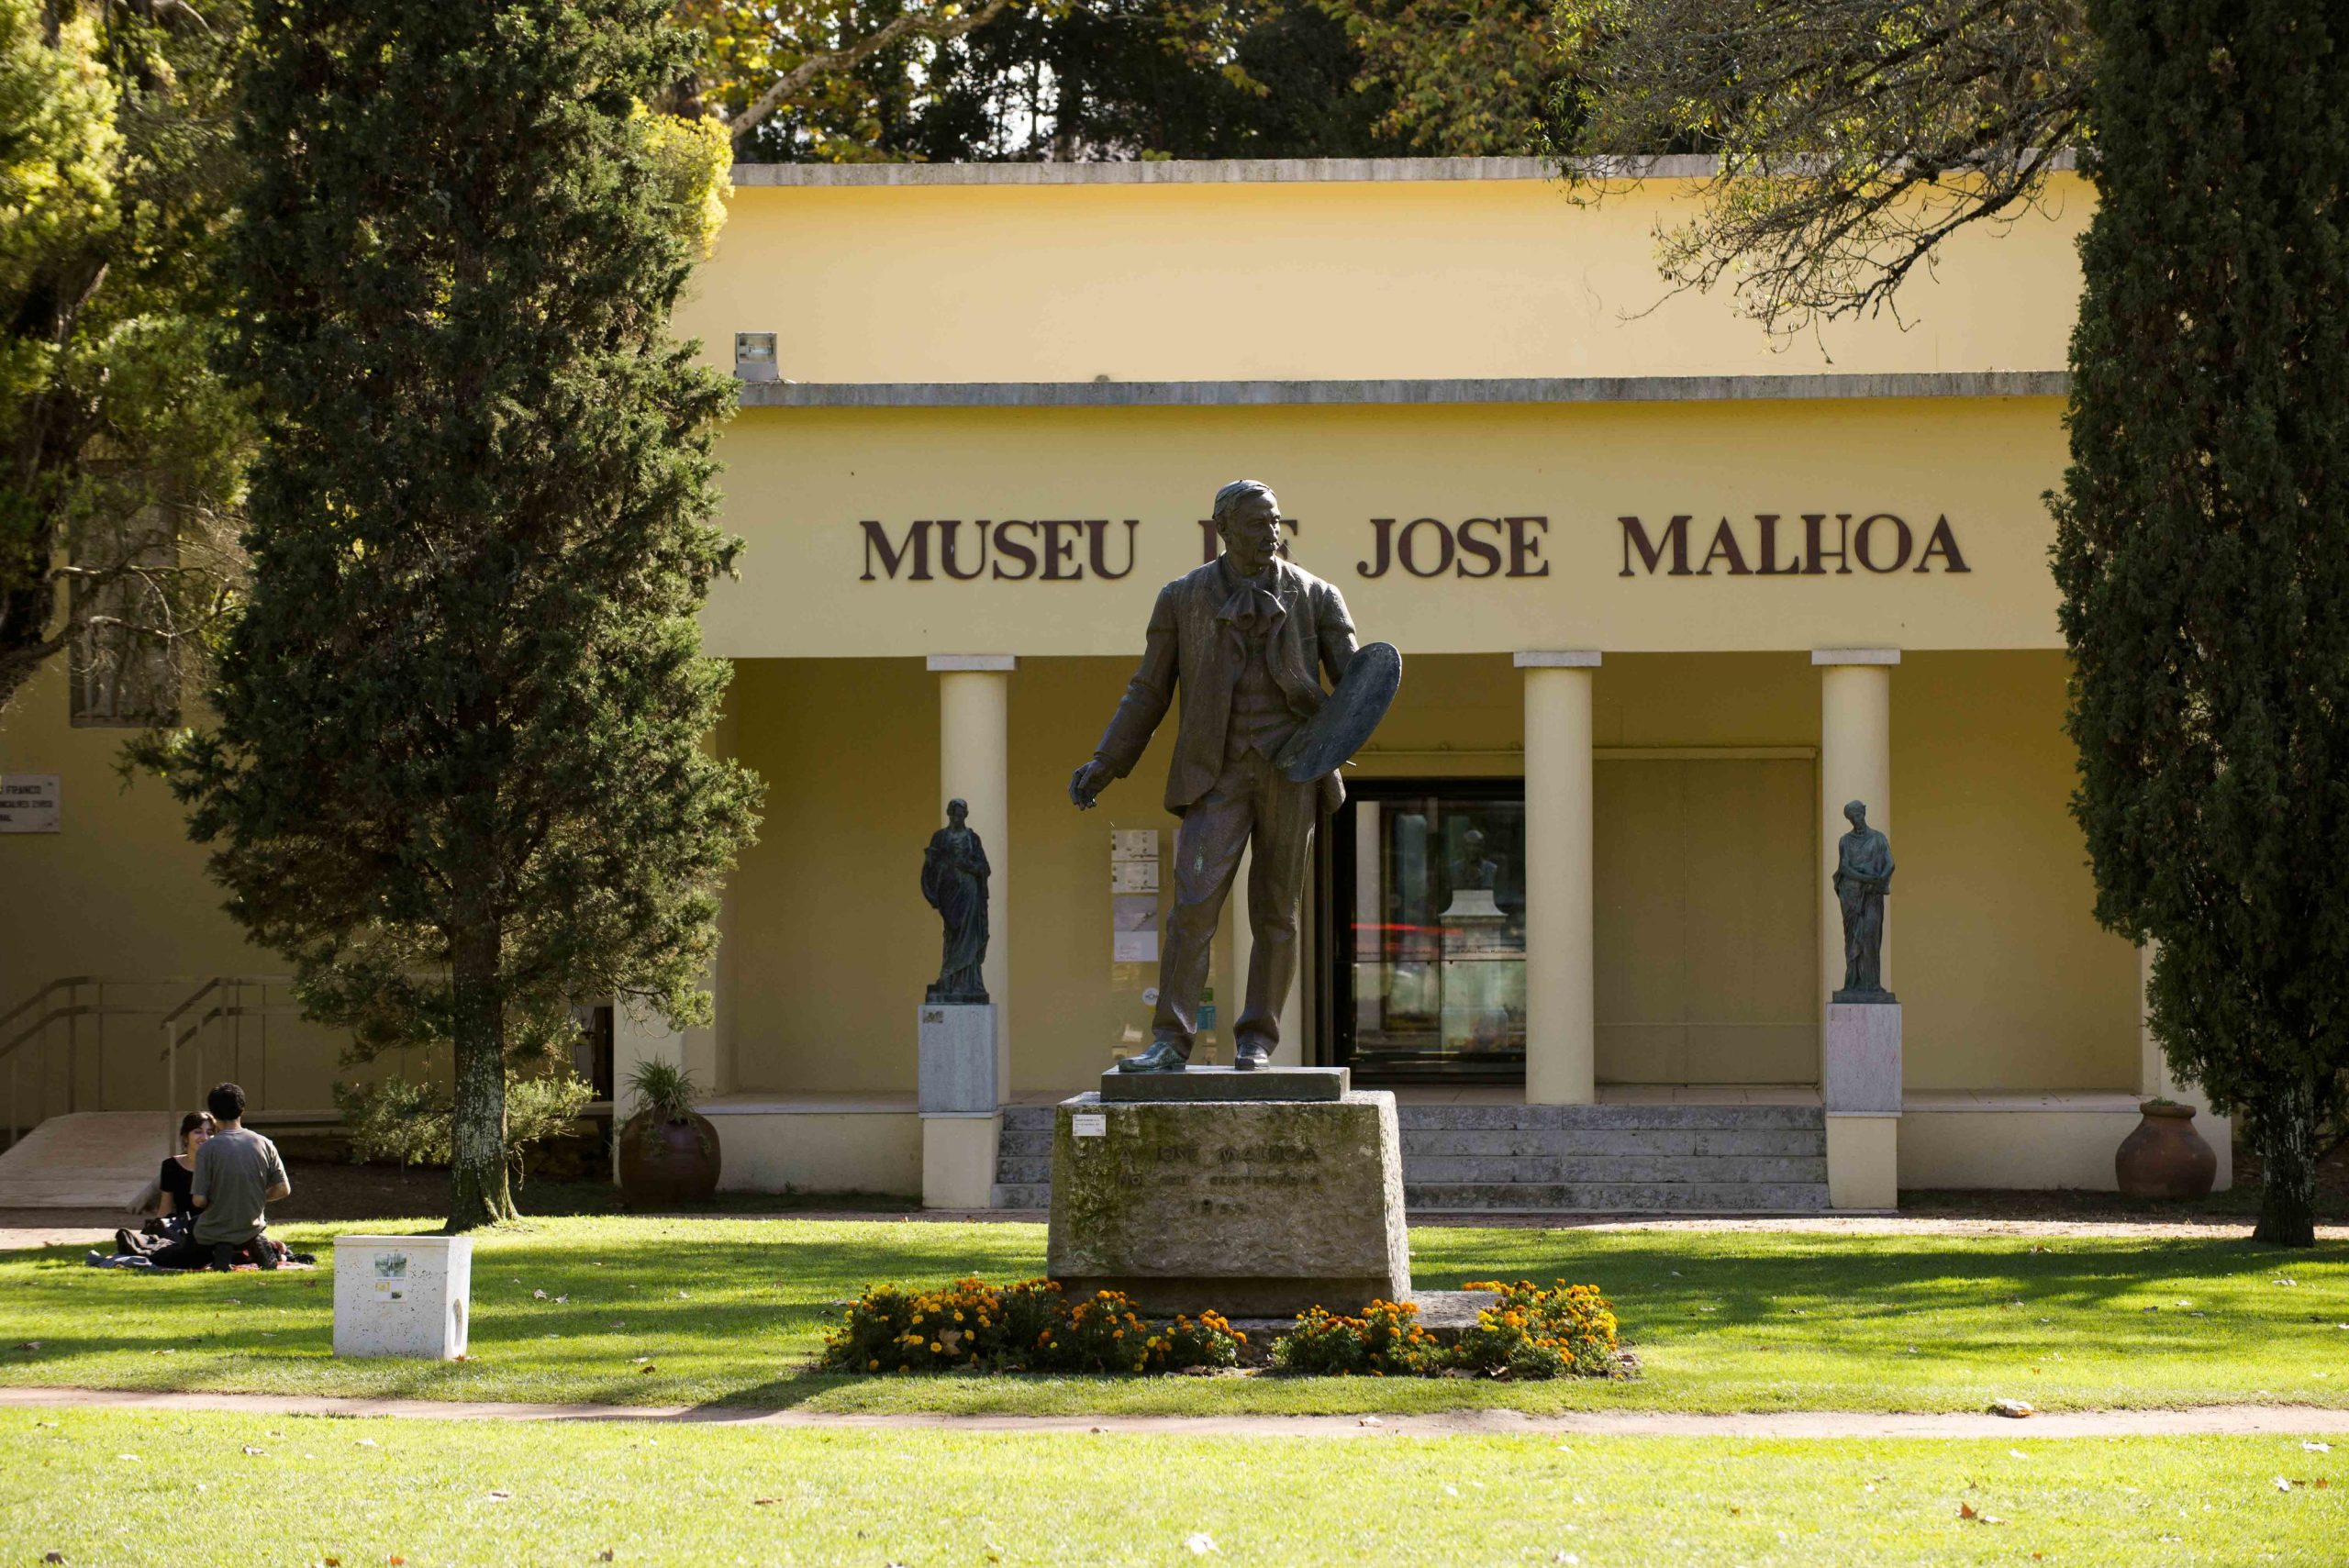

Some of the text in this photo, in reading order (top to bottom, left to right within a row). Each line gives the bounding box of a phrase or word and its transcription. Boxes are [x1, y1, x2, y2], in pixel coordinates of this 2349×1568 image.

[860, 520, 1139, 582] MUSEU
[1357, 517, 1549, 579] JOSE
[1618, 514, 1971, 577] MALHOA
